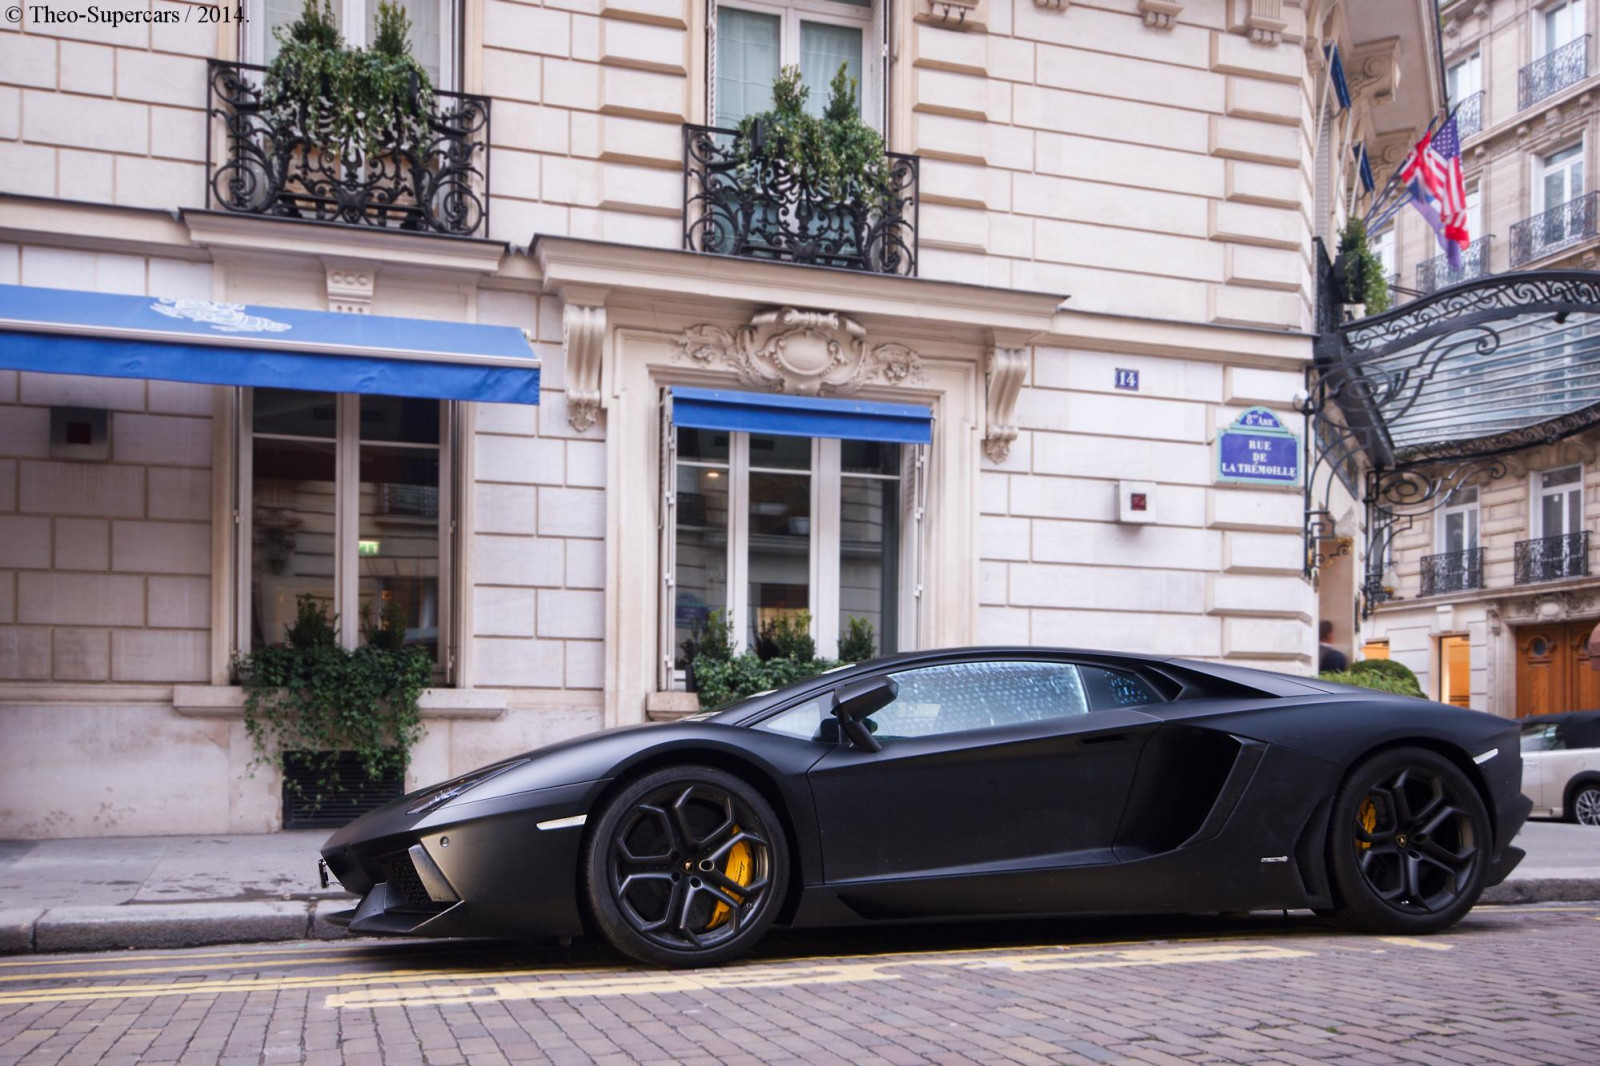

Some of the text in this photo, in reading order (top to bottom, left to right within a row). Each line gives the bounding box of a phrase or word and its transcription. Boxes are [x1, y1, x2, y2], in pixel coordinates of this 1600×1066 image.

[1119, 371, 1136, 387] 14
[1248, 440, 1272, 451] RUE
[1252, 452, 1267, 462] DE
[1222, 462, 1297, 477] LA TRÉMOILLE
